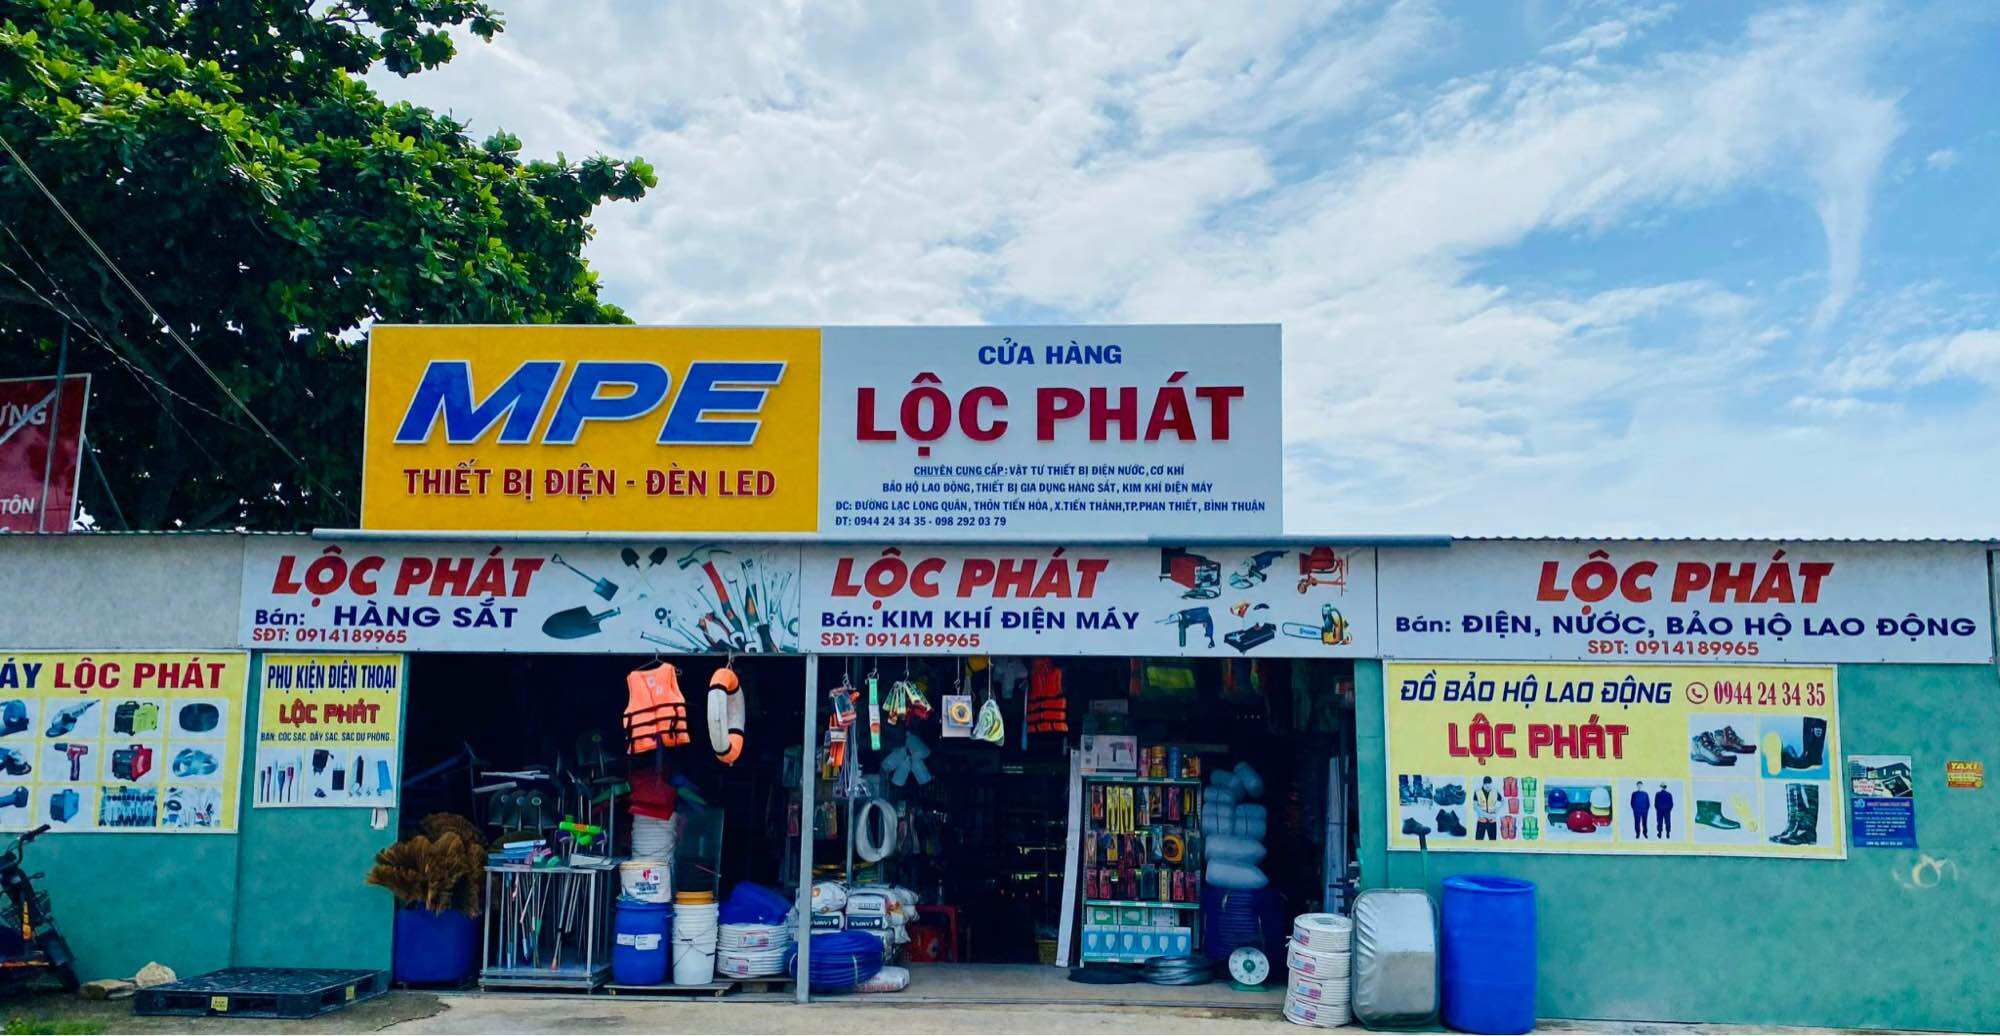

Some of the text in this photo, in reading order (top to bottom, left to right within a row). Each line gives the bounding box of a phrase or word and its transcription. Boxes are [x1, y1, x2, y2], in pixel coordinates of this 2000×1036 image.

[978, 337, 1122, 365] CỬA HÀNG
[393, 359, 788, 444] MPE
[856, 371, 1244, 457] LỘC PHÁT
[403, 458, 491, 494] THIẾT
[503, 468, 533, 500] BỊ
[544, 463, 616, 501] ĐIỆN
[646, 463, 706, 496] ĐÈN
[719, 470, 776, 496] LED
[914, 465, 953, 476] CHUYÊN
[955, 466, 982, 476] CUNG
[1047, 463, 1075, 476] THIẾT
[1079, 466, 1088, 477] BỊ
[922, 483, 940, 493] LAO
[976, 480, 1004, 493] THIẾT
[1008, 483, 1018, 495] BỊ
[1020, 483, 1036, 493] GIA
[1122, 483, 1142, 493] KIM
[1165, 480, 1188, 495] ĐIỆN
[913, 501, 938, 511] LONG
[1204, 498, 1228, 512] BÌNH
[854, 516, 880, 526] 0944
[882, 516, 894, 526] 24
[898, 516, 910, 526] 34
[914, 516, 926, 526] 35
[935, 516, 954, 526] 098
[957, 516, 975, 526] 292
[978, 516, 990, 526] 03
[994, 516, 1006, 527] 79
[272, 545, 545, 607] LỘC PHÁT
[831, 546, 1109, 610] LỘC PHÁT
[1536, 549, 1834, 616] LỘC PHÁT
[255, 597, 518, 628] Bán: HÀNG SẮT
[821, 606, 1139, 634] Bán: KIM KHÍ ĐIỆN MÁY
[1396, 610, 1976, 641] Bán: ĐIỆN, NƯỚC, BẢO HỘ LAO ĐỘNG
[252, 628, 407, 643] SĐT: 0914189965
[821, 632, 980, 647] SĐT: 0914189965
[1588, 640, 1759, 656] SĐT: 0914189965
[54, 658, 120, 694] LỘC
[133, 658, 226, 688] PHÁT
[268, 660, 396, 693] PHỤ KIỆN ĐIỆN THOẠI
[1401, 670, 1826, 710] ĐỒ BẢO HỘ LAO ĐỘNG 0944 24 34 35
[279, 698, 380, 727] LỘC PHÁT
[1448, 712, 1628, 765] LỘC PHÁT
